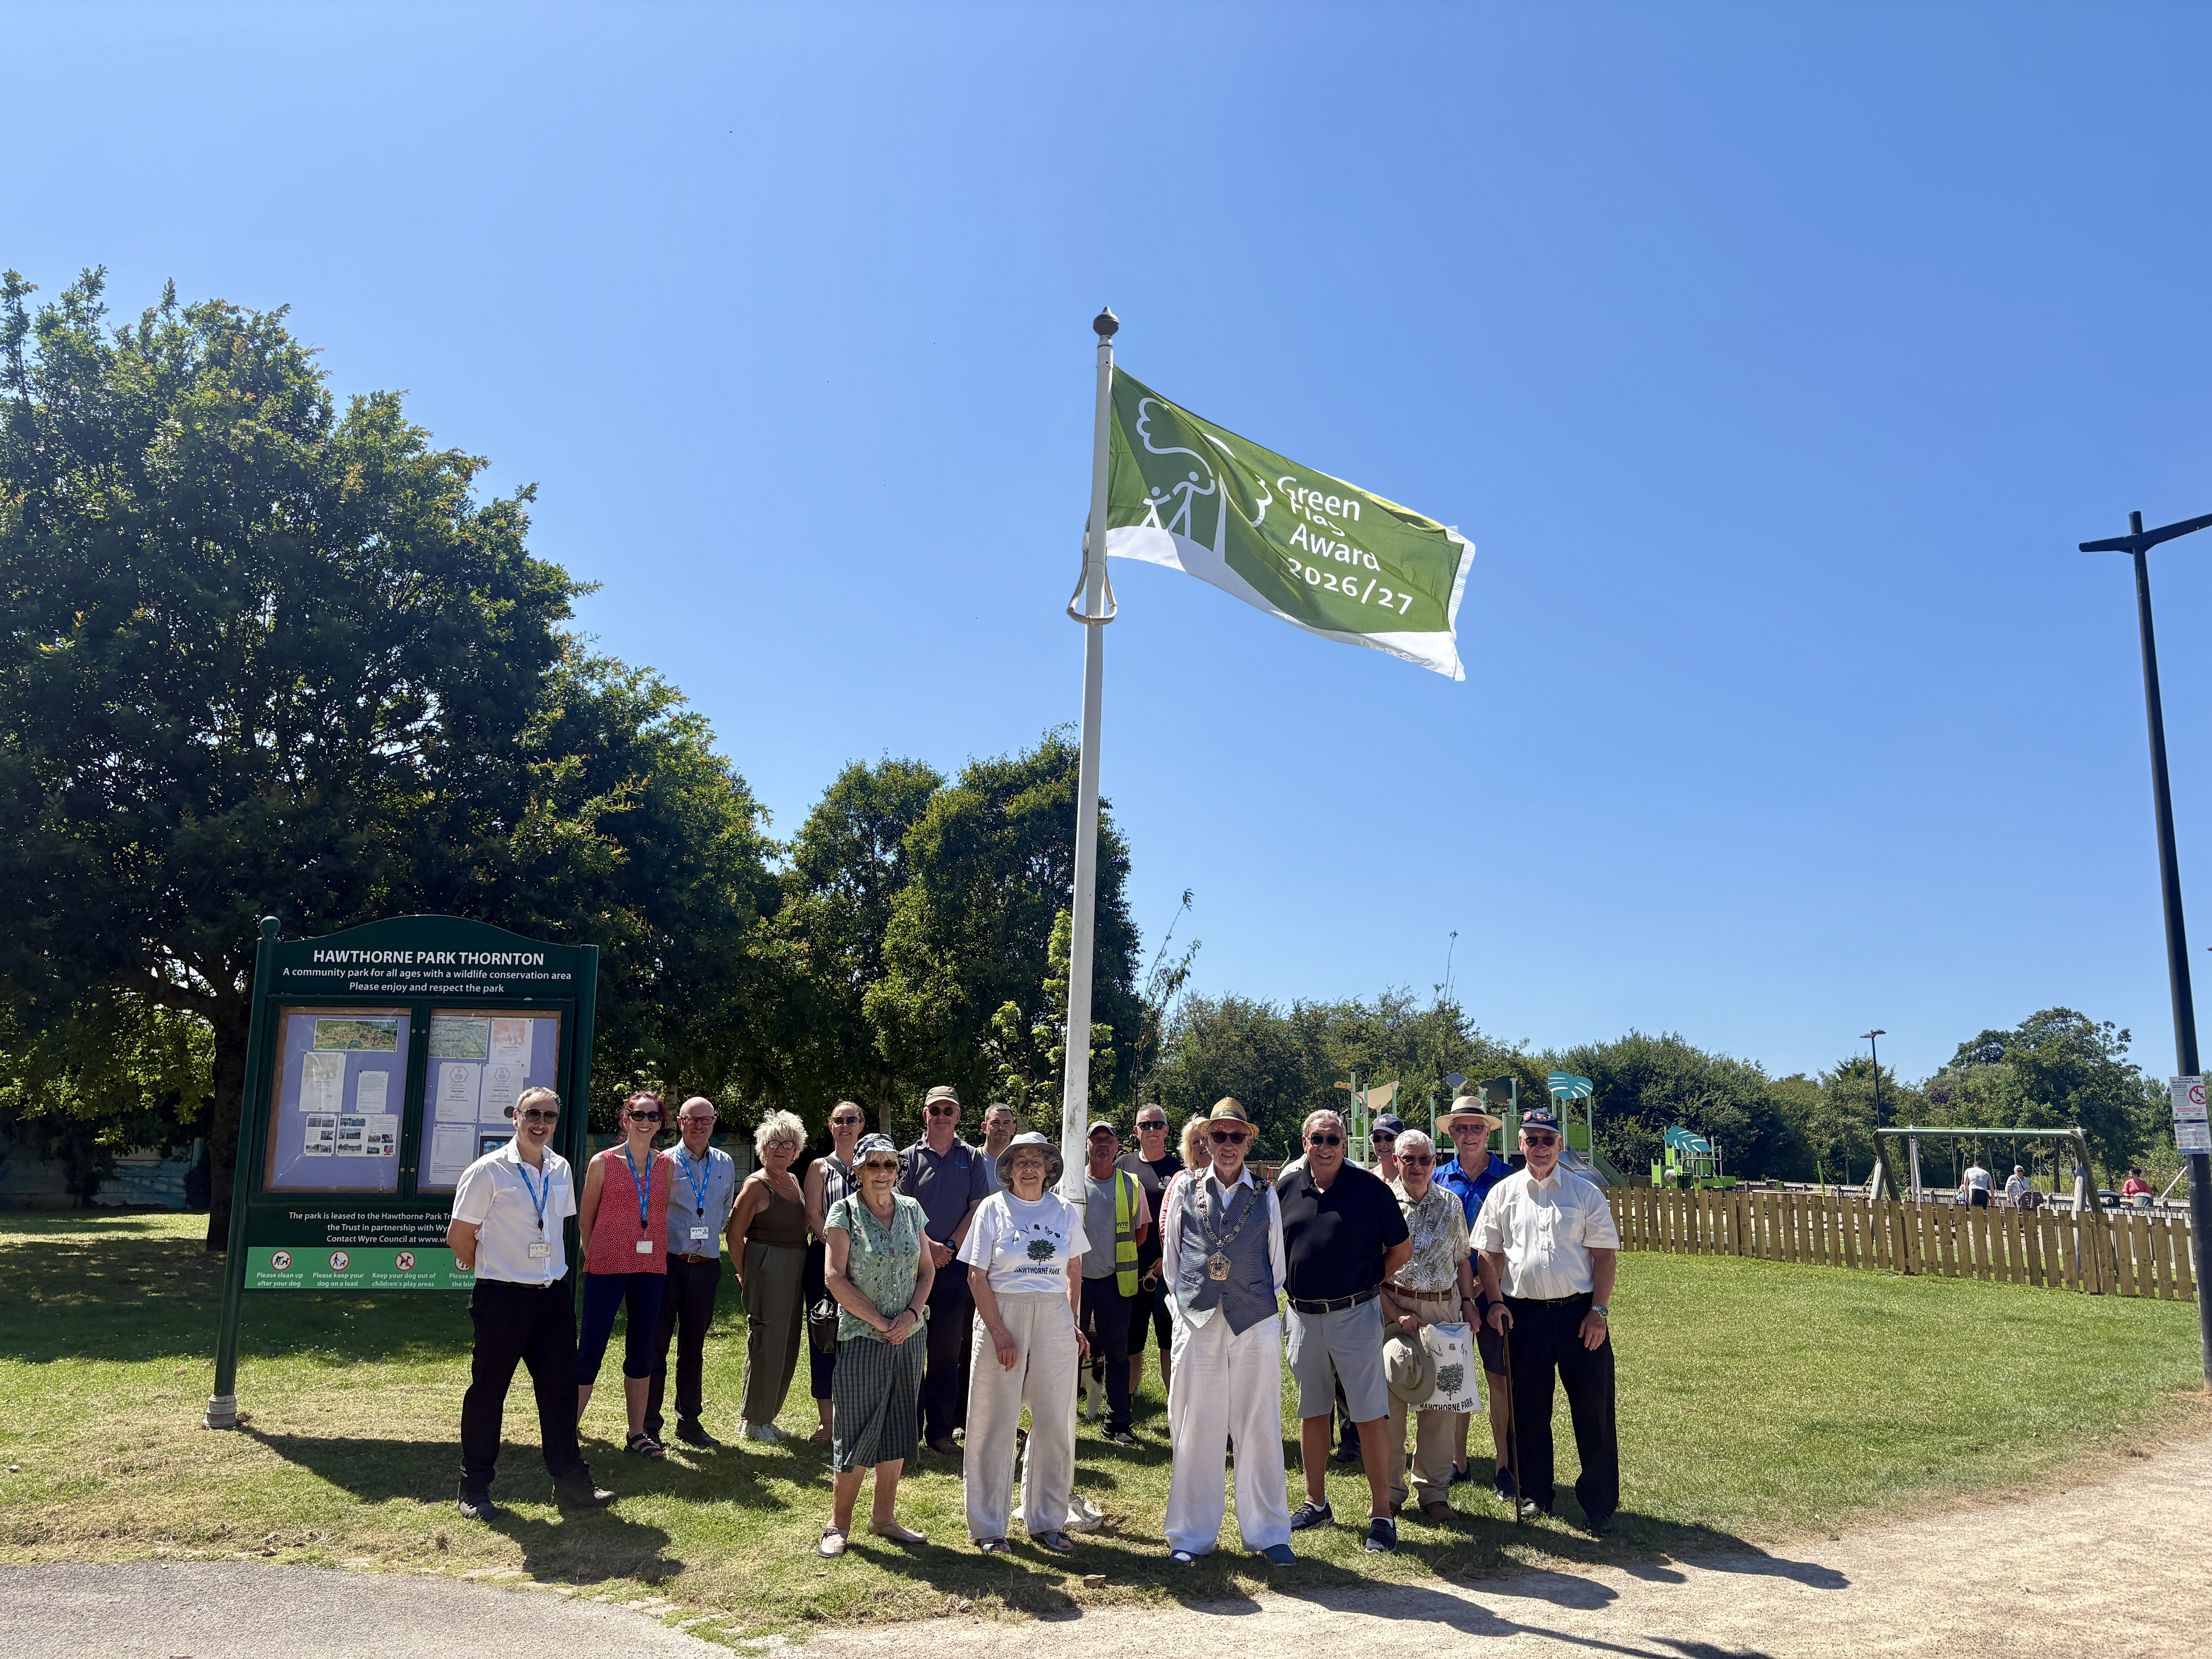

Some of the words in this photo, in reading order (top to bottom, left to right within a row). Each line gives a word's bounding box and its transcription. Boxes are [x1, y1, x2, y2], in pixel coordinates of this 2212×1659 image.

[1277, 476, 1360, 521] Green
[1290, 523, 1381, 572] Award
[1288, 558, 1413, 615] 2026/27
[313, 950, 413, 963] HAWTHORNE
[417, 951, 456, 964] PARK
[459, 952, 544, 965] THORNTON
[283, 967, 290, 975] A
[292, 968, 345, 978] community
[348, 968, 369, 979] park
[371, 969, 384, 977] for
[386, 969, 397, 977] all
[400, 970, 421, 979] ages
[423, 969, 443, 978] with
[453, 970, 488, 978] wildlife
[489, 971, 549, 979] conservation
[349, 982, 379, 991] Please
[381, 982, 407, 993] enjoy
[409, 983, 426, 991] and
[429, 984, 464, 993] respect
[465, 984, 481, 992] the
[483, 984, 504, 994] park
[304, 1212, 322, 1221] park
[371, 1224, 416, 1233] partnership
[358, 1235, 377, 1244] Wyre
[1420, 1403, 1460, 1412] HAWTHORNE
[1461, 1397, 1474, 1410] PARK
